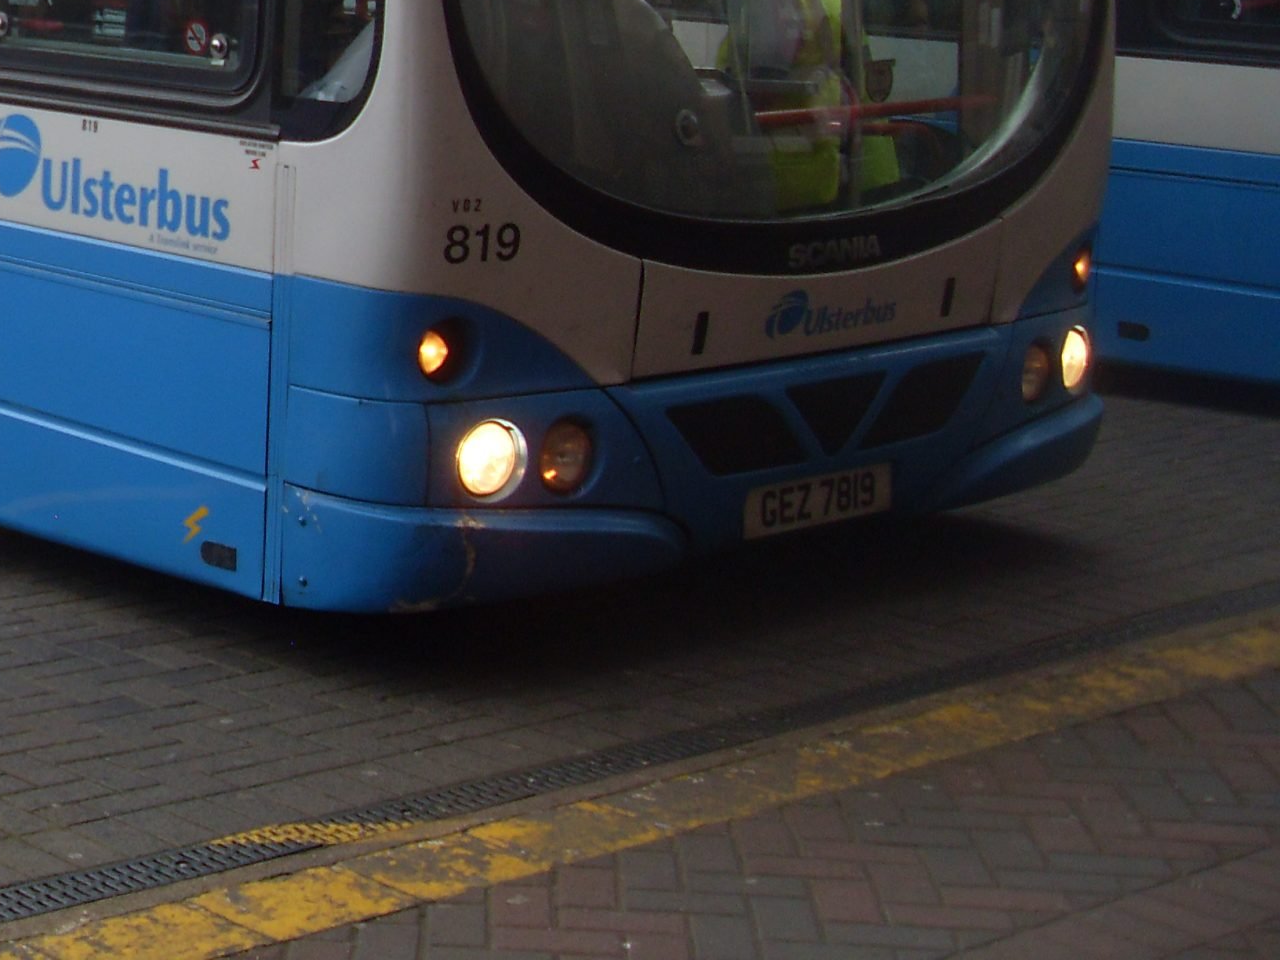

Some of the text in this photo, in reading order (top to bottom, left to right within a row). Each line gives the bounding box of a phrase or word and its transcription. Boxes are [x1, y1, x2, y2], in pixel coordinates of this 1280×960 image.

[82, 119, 99, 133] 819
[42, 158, 231, 241] Ulsterbus
[443, 223, 521, 264] 819
[787, 234, 882, 268] SCANIA
[804, 297, 897, 337] Ulsterbus
[760, 470, 876, 529] GEZ 7819
